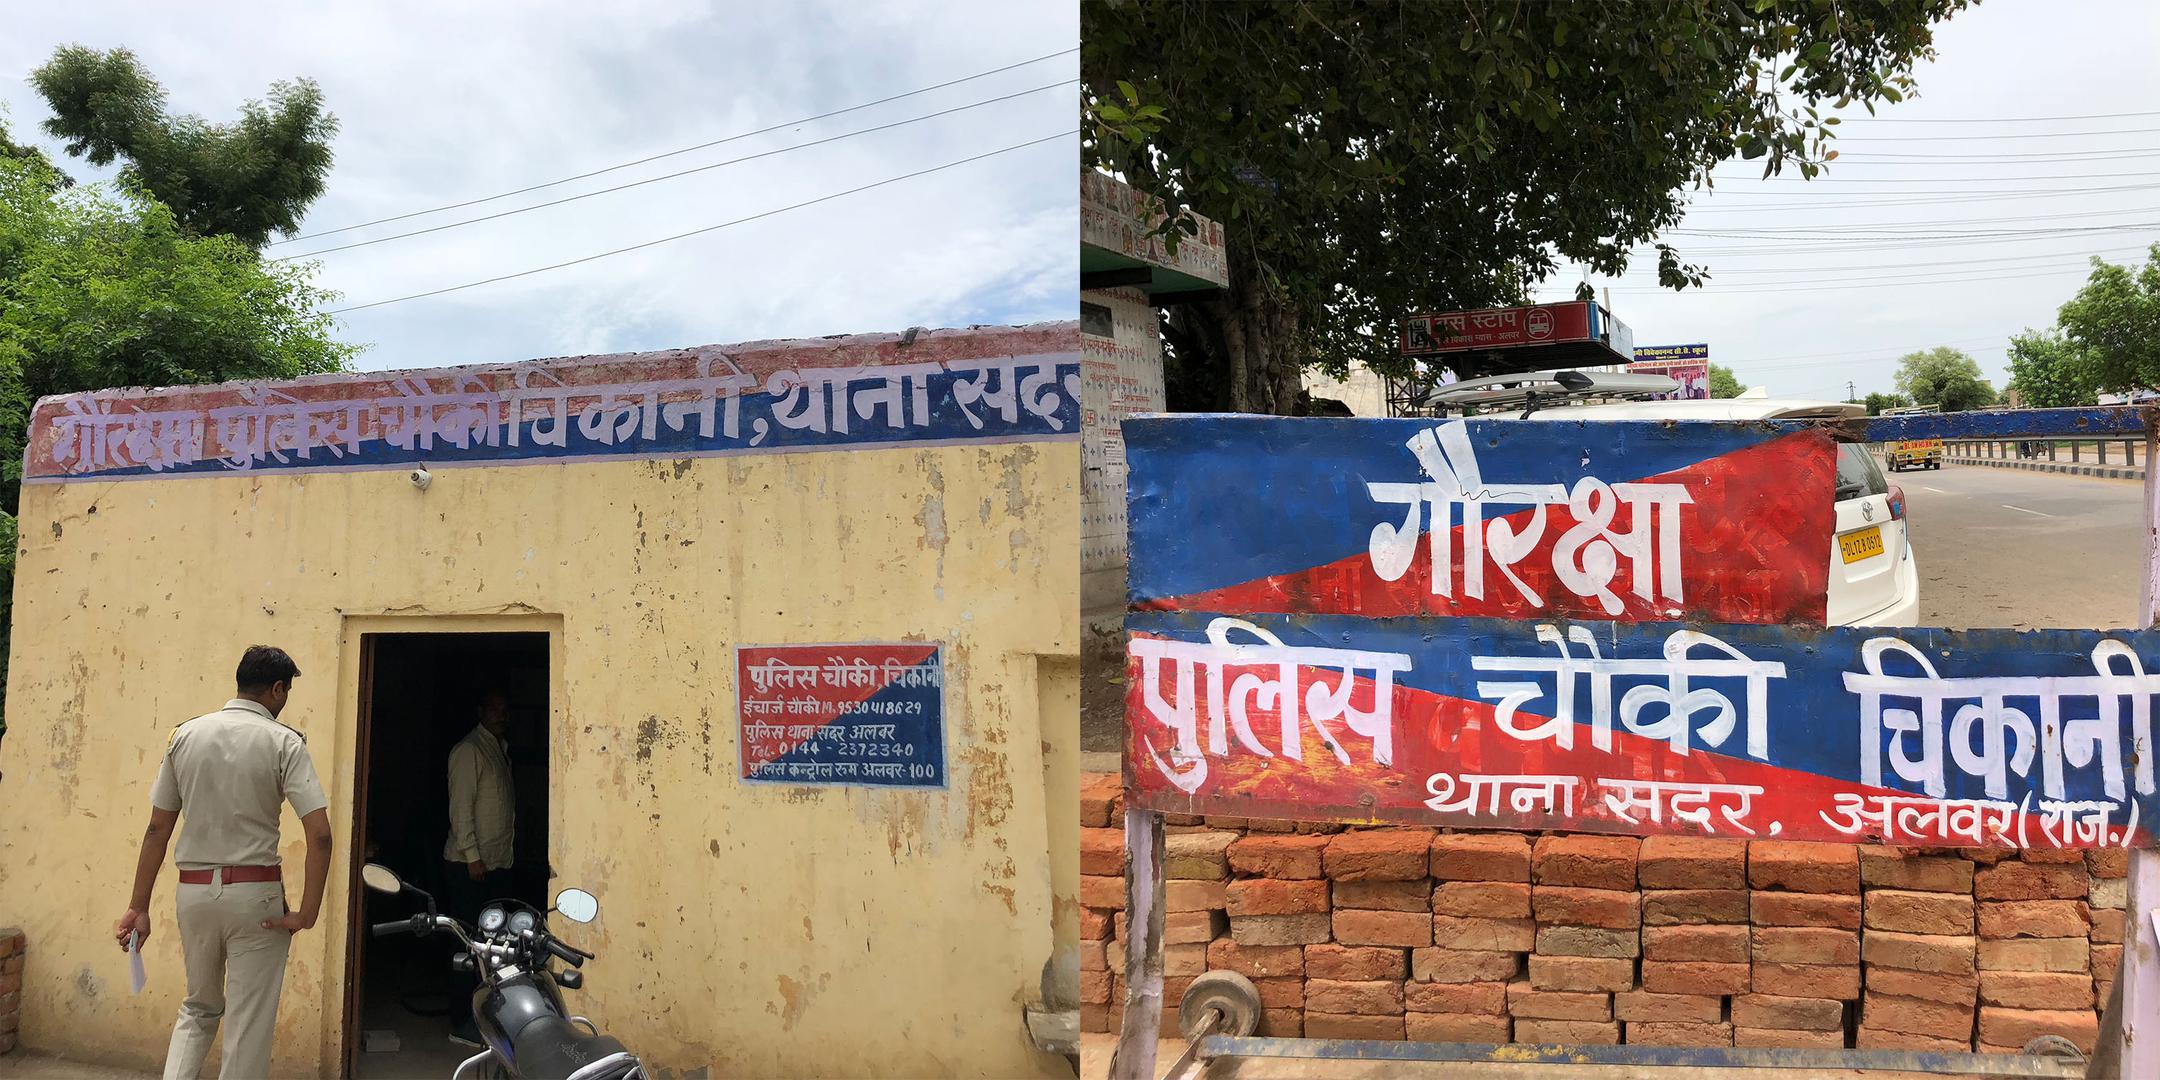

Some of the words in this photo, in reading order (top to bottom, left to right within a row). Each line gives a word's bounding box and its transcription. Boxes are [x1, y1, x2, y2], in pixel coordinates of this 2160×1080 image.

[51, 399, 203, 471] गौरक्षा
[209, 384, 372, 471] पुलिस
[381, 377, 503, 450] चौकी
[769, 365, 945, 434] थाना
[1366, 419, 1695, 616] गौरक्षा
[747, 657, 820, 693] पुलिस
[880, 656, 940, 689] चिकानी
[786, 694, 820, 715] चौकी
[1128, 617, 1413, 795] पुलिस
[1471, 623, 1787, 760] चौकी
[1842, 636, 2160, 802] चिकानी
[744, 719, 786, 744] पुलिस
[787, 724, 814, 740] थाना
[816, 724, 846, 743] सदर
[849, 723, 896, 741] अलवर
[779, 741, 820, 755] 0144
[838, 742, 914, 757] 2372340
[1423, 772, 1579, 817] थाना
